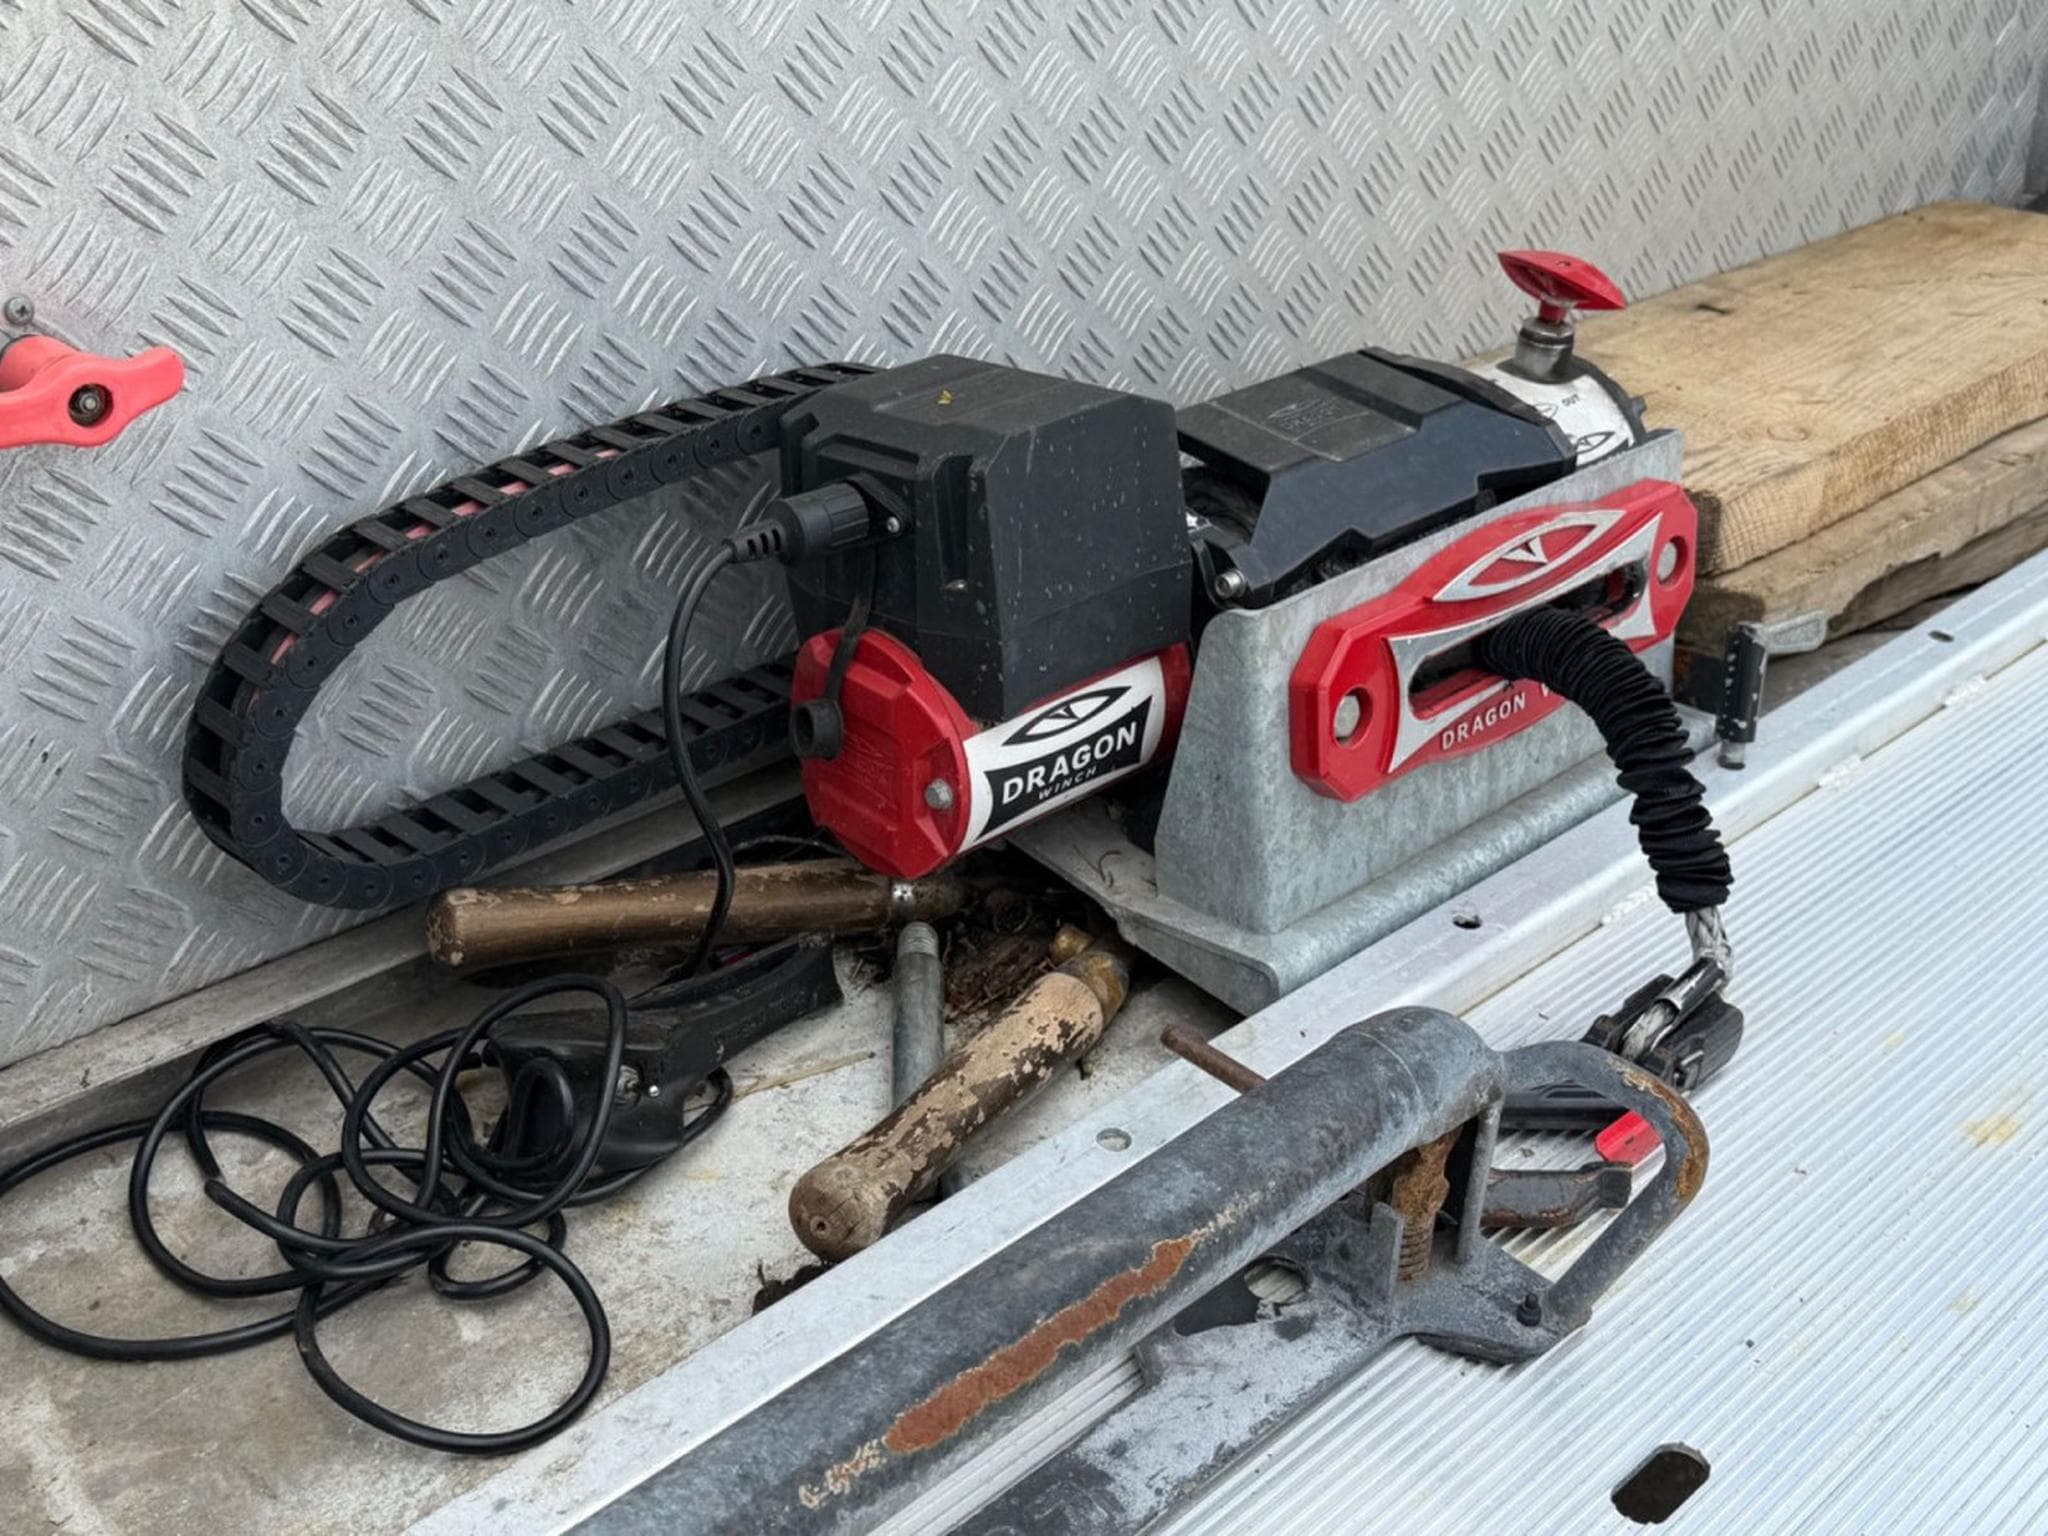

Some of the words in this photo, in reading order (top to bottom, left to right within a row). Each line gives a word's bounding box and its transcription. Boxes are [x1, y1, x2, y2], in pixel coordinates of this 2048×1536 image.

[1442, 691, 1526, 750] DRAGON
[1002, 721, 1138, 805] DRAGON
[1038, 766, 1097, 800] WINCH
